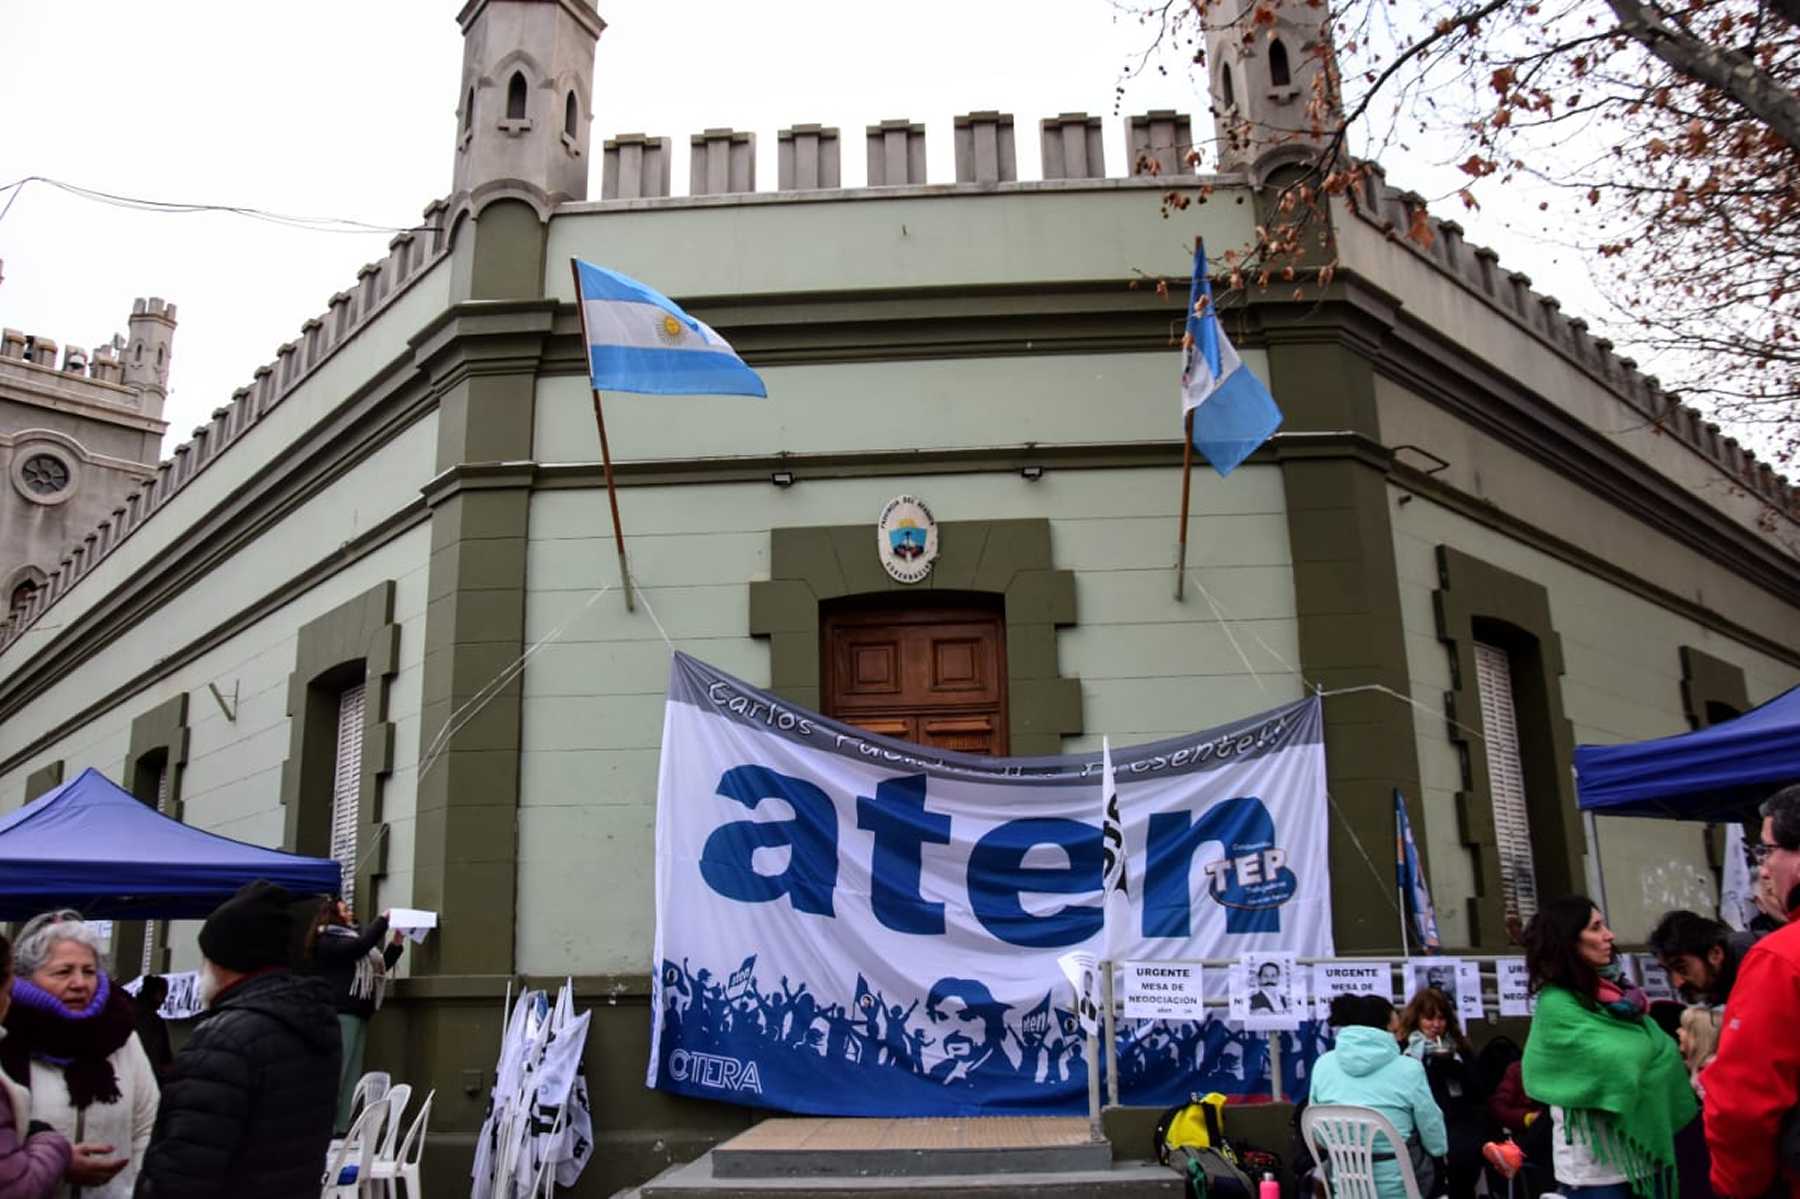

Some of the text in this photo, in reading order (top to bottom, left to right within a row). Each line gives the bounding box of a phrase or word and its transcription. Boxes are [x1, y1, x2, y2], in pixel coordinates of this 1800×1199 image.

[708, 681, 815, 735] Carlos
[699, 764, 1281, 947] aten
[1204, 848, 1288, 893] TEP
[1136, 967, 1191, 978] URGENTE
[1326, 968, 1379, 978] URGENTE
[1141, 982, 1185, 992] MESA DE
[1331, 983, 1373, 991] MESA DE
[1128, 994, 1198, 1005] NEGOCIACIÓN
[668, 1048, 763, 1095] CTERA
